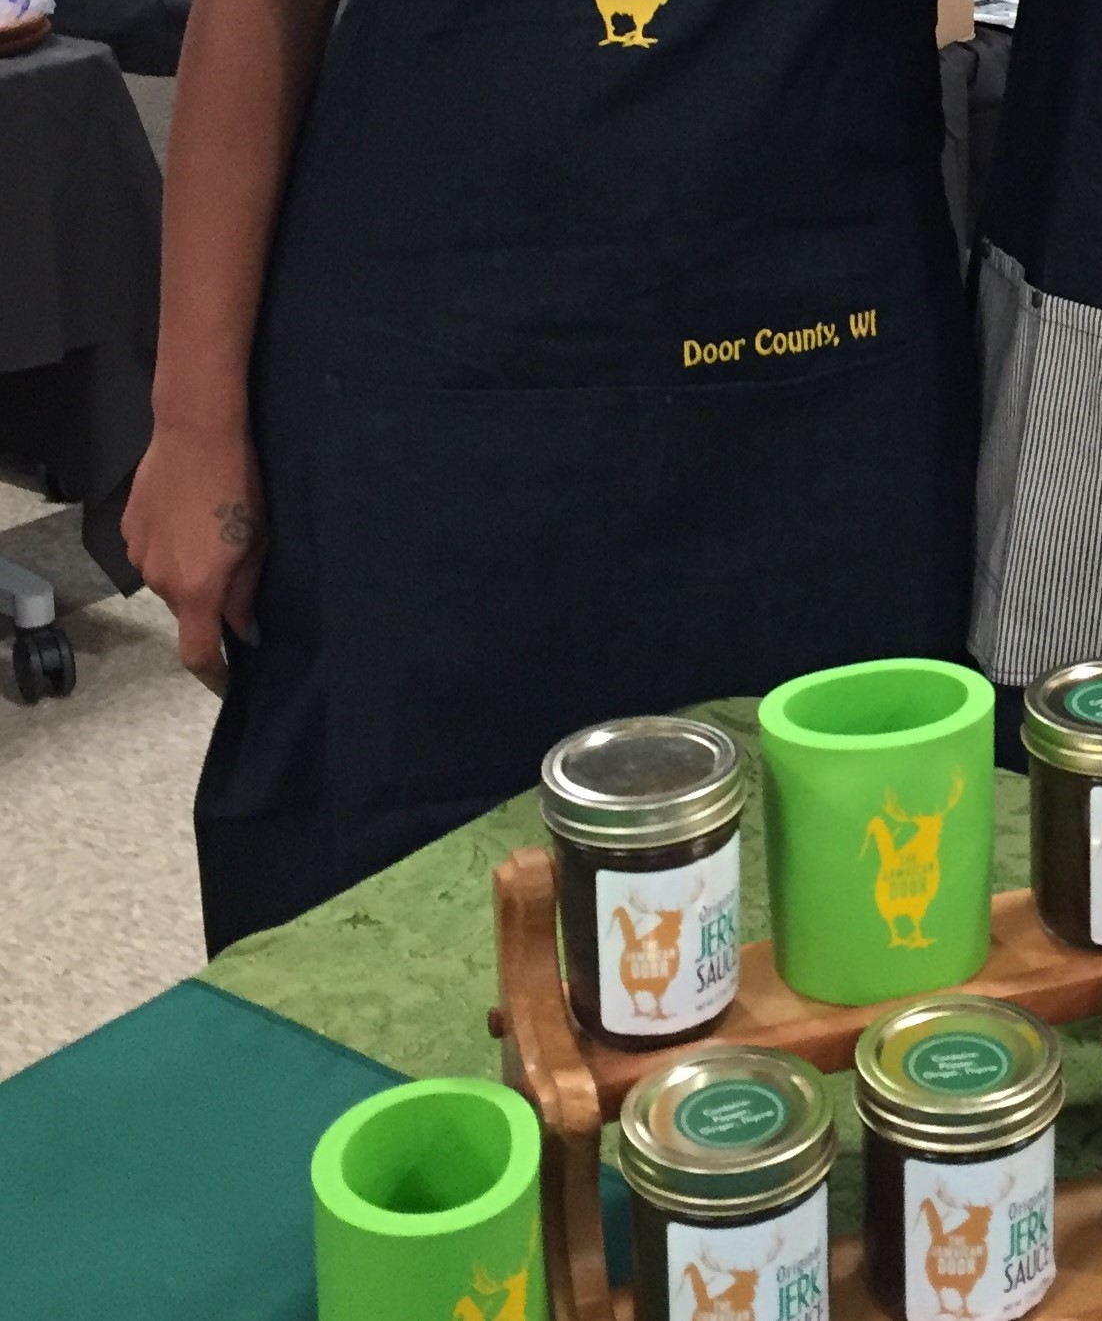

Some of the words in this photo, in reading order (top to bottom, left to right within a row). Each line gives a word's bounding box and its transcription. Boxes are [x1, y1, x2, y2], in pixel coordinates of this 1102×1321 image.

[683, 338, 746, 367] Door
[755, 321, 840, 356] County,
[849, 309, 877, 339] WI
[1003, 1203, 1049, 1263] JERK
[777, 1262, 822, 1321] JERK
